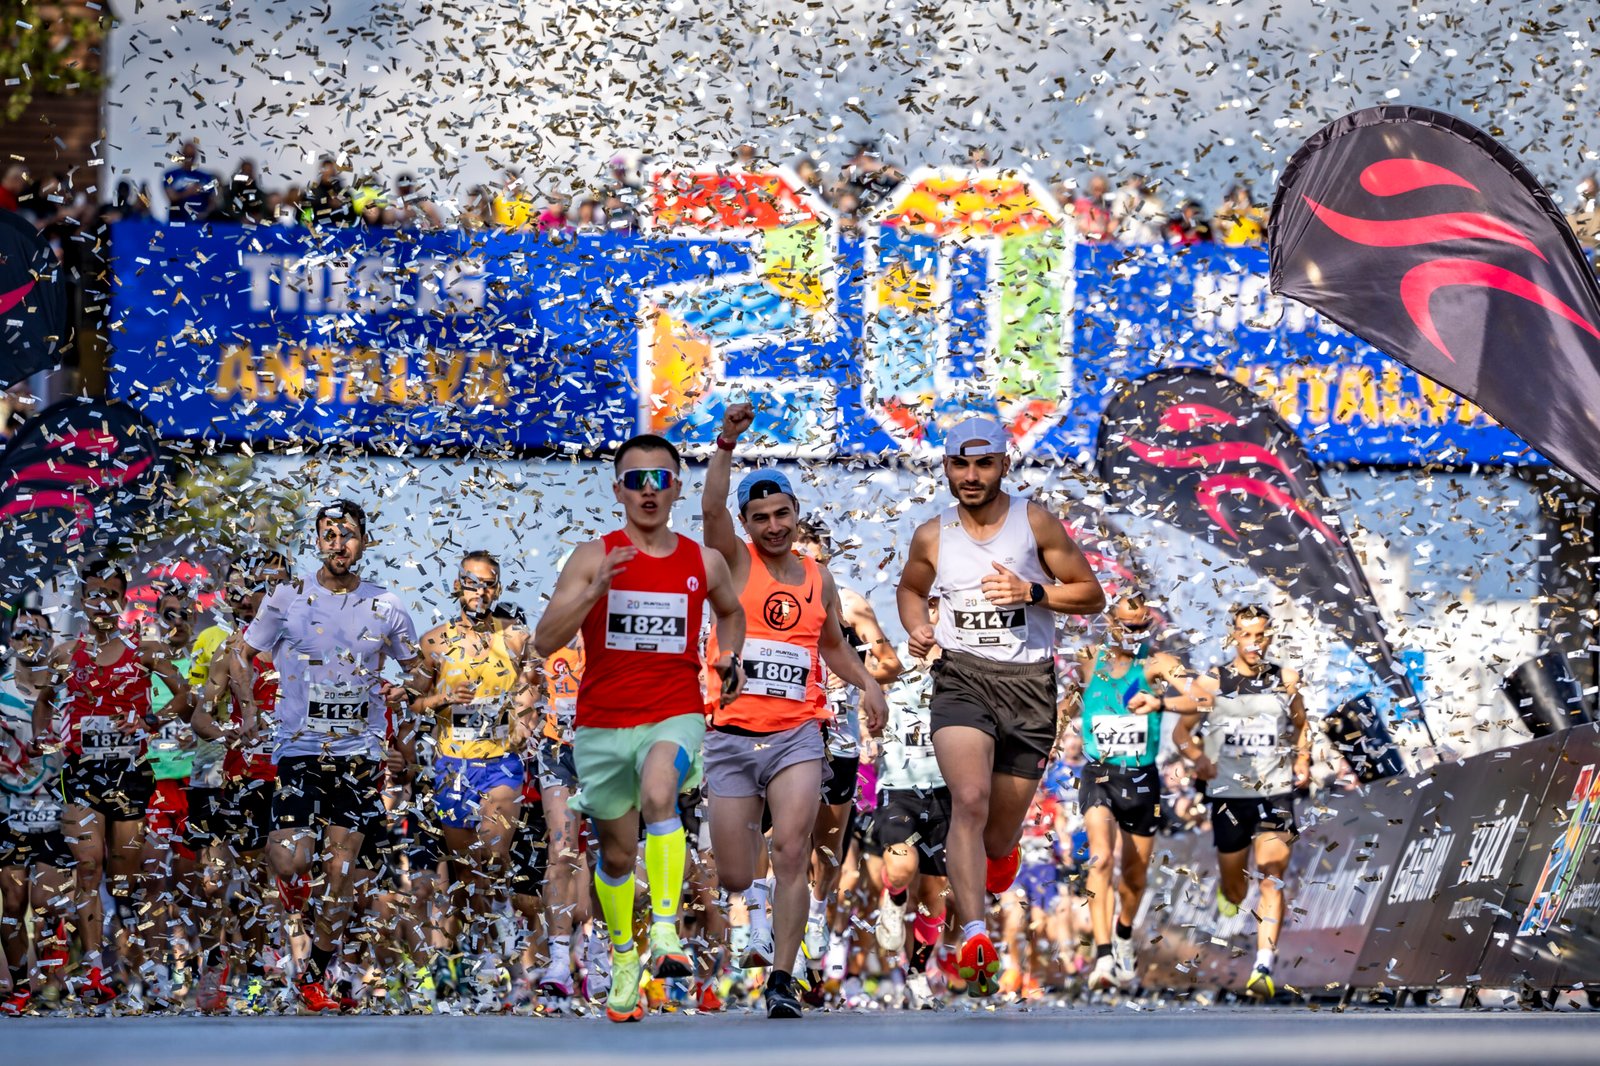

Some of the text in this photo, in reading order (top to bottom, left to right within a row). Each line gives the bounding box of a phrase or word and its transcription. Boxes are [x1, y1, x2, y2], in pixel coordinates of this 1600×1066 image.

[636, 164, 1077, 461] 20
[211, 344, 509, 406] ANTALYA
[626, 599, 640, 609] 20
[965, 598, 977, 607] 20
[620, 615, 678, 635] 1824
[961, 611, 1016, 629] 2147
[760, 647, 772, 657] 20
[753, 662, 803, 684] 1802
[324, 691, 336, 699] 20
[19, 810, 57, 822] 1652
[1387, 833, 1457, 905] GARMIN
